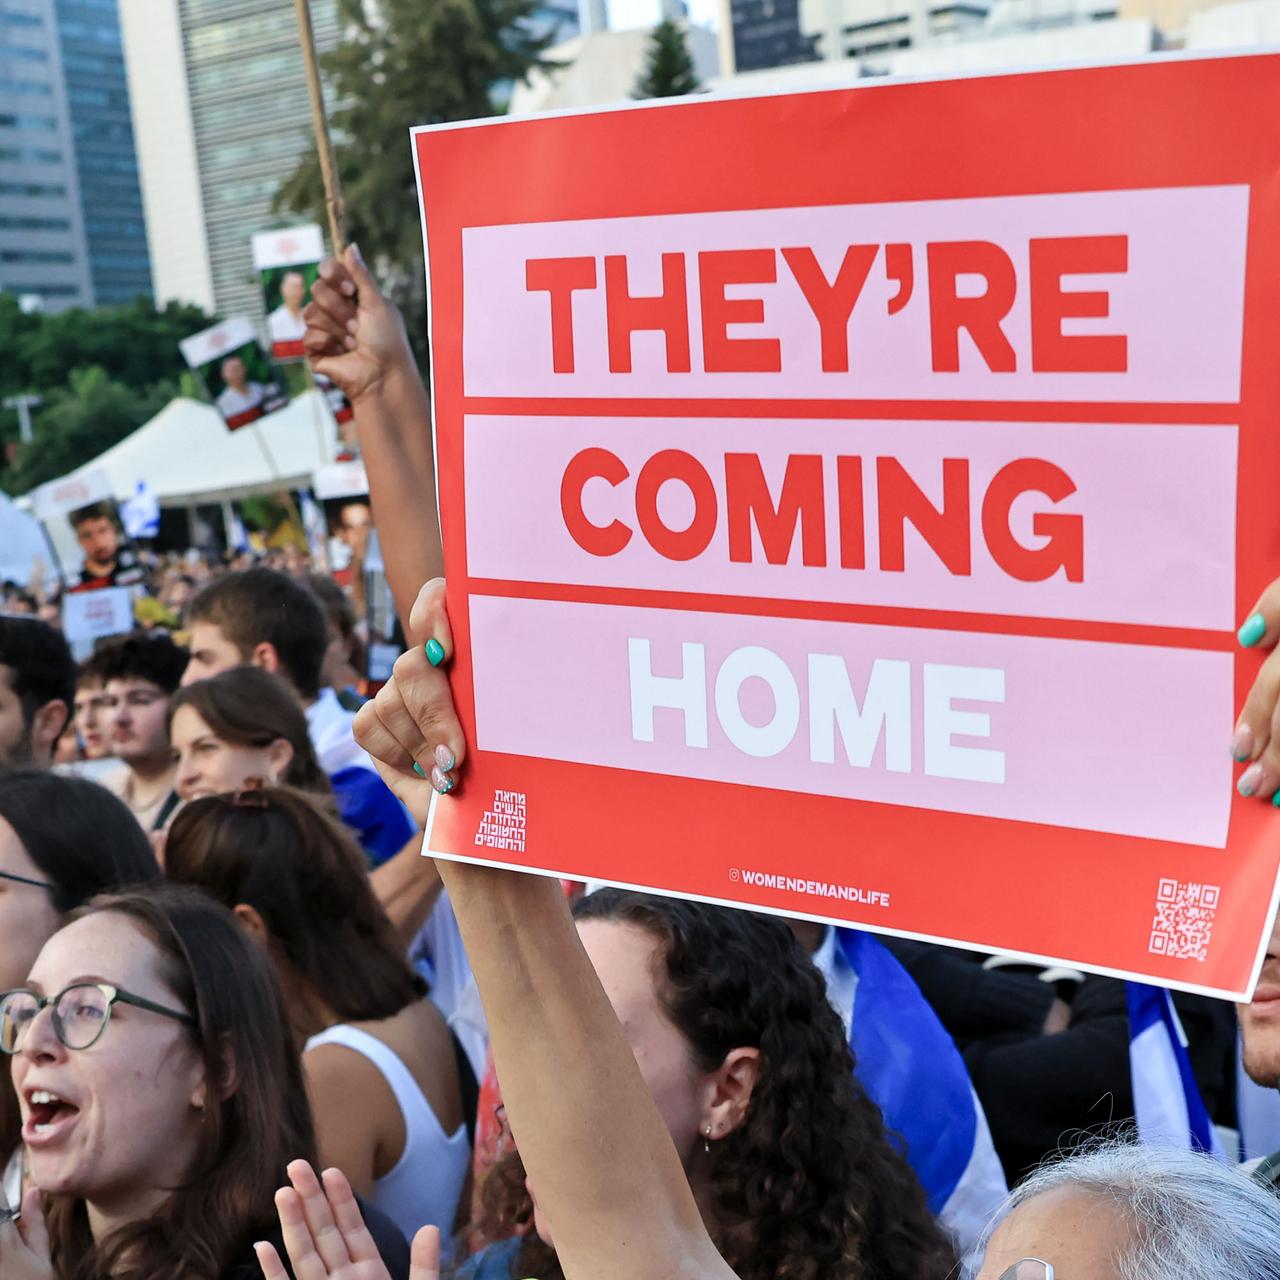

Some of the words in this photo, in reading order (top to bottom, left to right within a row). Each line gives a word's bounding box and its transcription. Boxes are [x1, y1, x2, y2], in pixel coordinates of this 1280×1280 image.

[525, 234, 1128, 374] THEY'RE
[560, 447, 1084, 584] COMING
[627, 638, 1005, 784] HOME
[495, 789, 526, 805] מחאת
[494, 801, 526, 816] הנשים
[483, 811, 526, 828] להחזרת
[479, 821, 526, 840] החטופות
[475, 834, 526, 852] והחטופים
[742, 870, 890, 907] WOMENDEMANDLIFE
